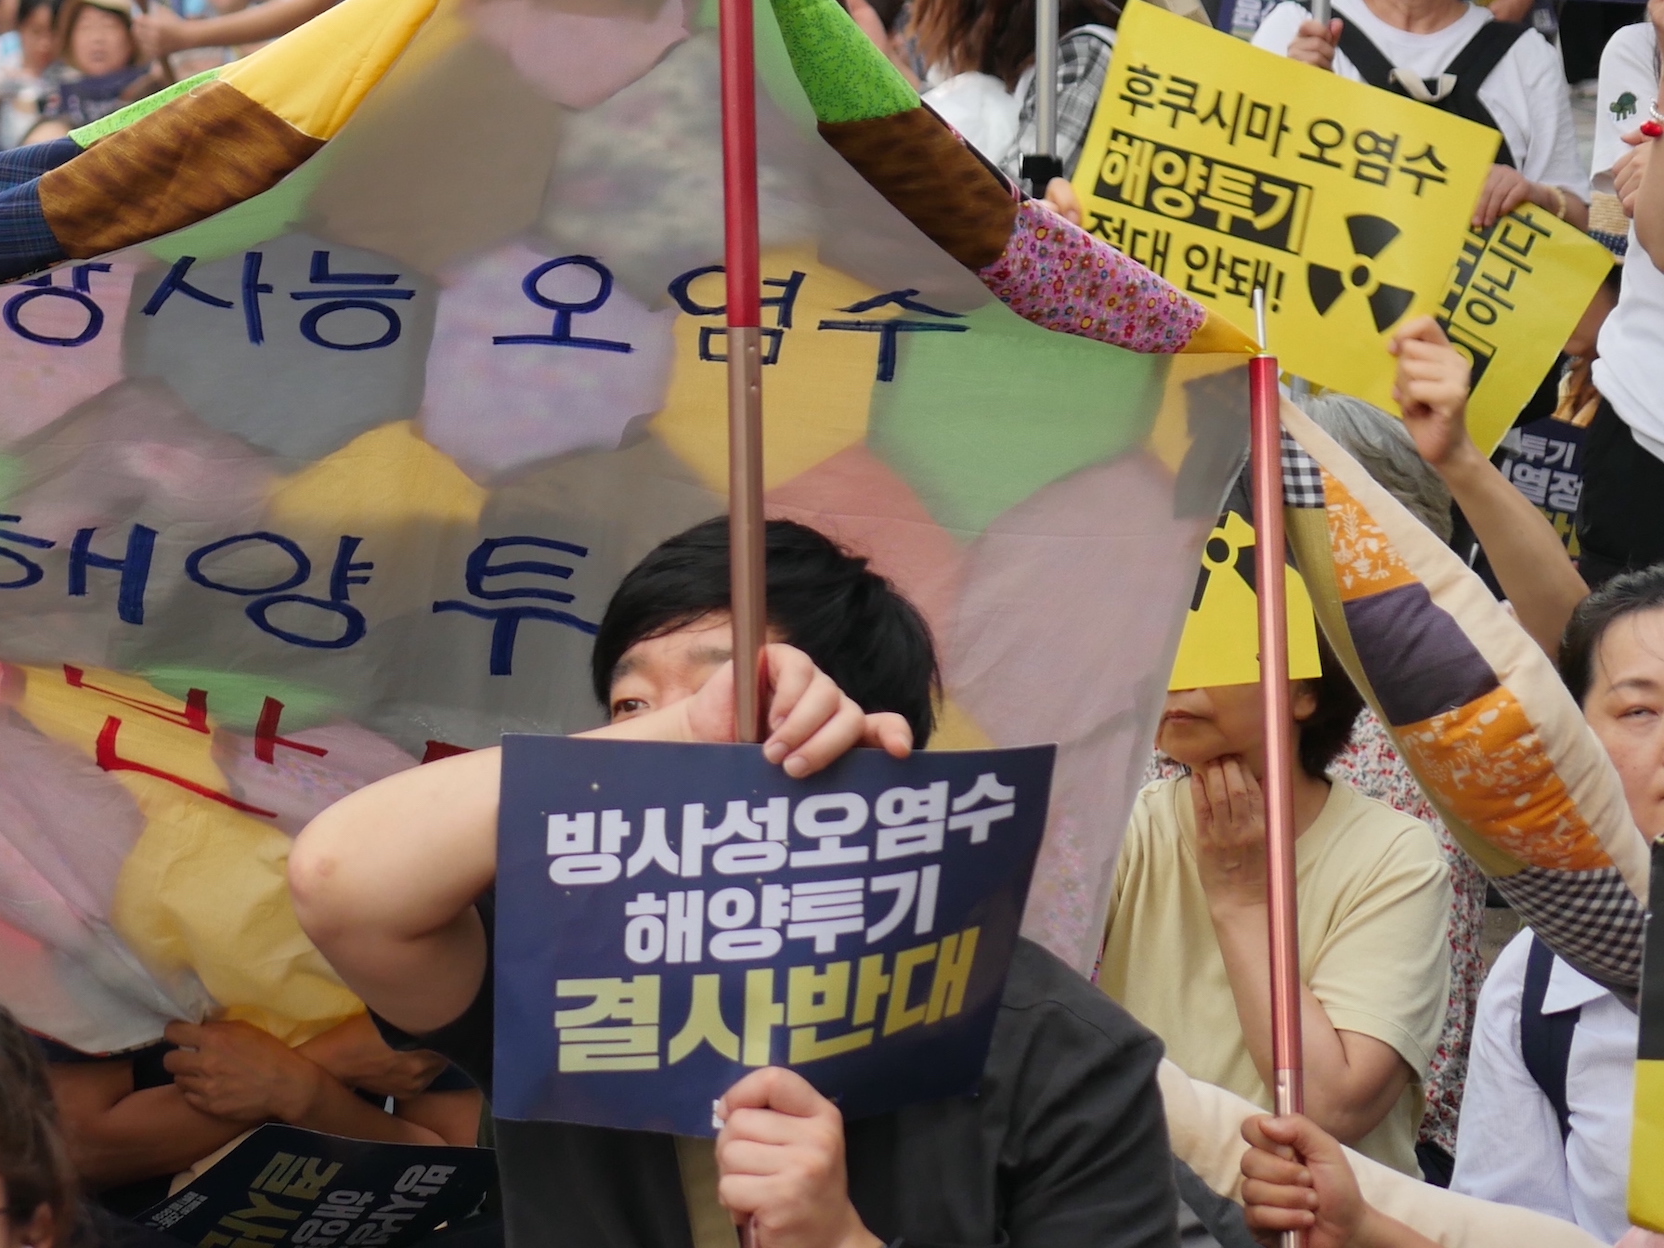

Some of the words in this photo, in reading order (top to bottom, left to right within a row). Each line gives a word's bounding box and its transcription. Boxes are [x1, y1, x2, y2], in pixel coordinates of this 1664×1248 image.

[1119, 64, 1291, 158] 후쿠시마
[1298, 117, 1449, 197] 오염수
[1101, 133, 1312, 252] 해양투기
[1183, 243, 1284, 313] 안돼!
[1465, 210, 1552, 326] 아니다
[432, 537, 602, 676] 투
[546, 772, 1016, 885] 방사성오염수
[624, 864, 941, 964] 해양투기
[554, 926, 980, 1073] 결사반대
